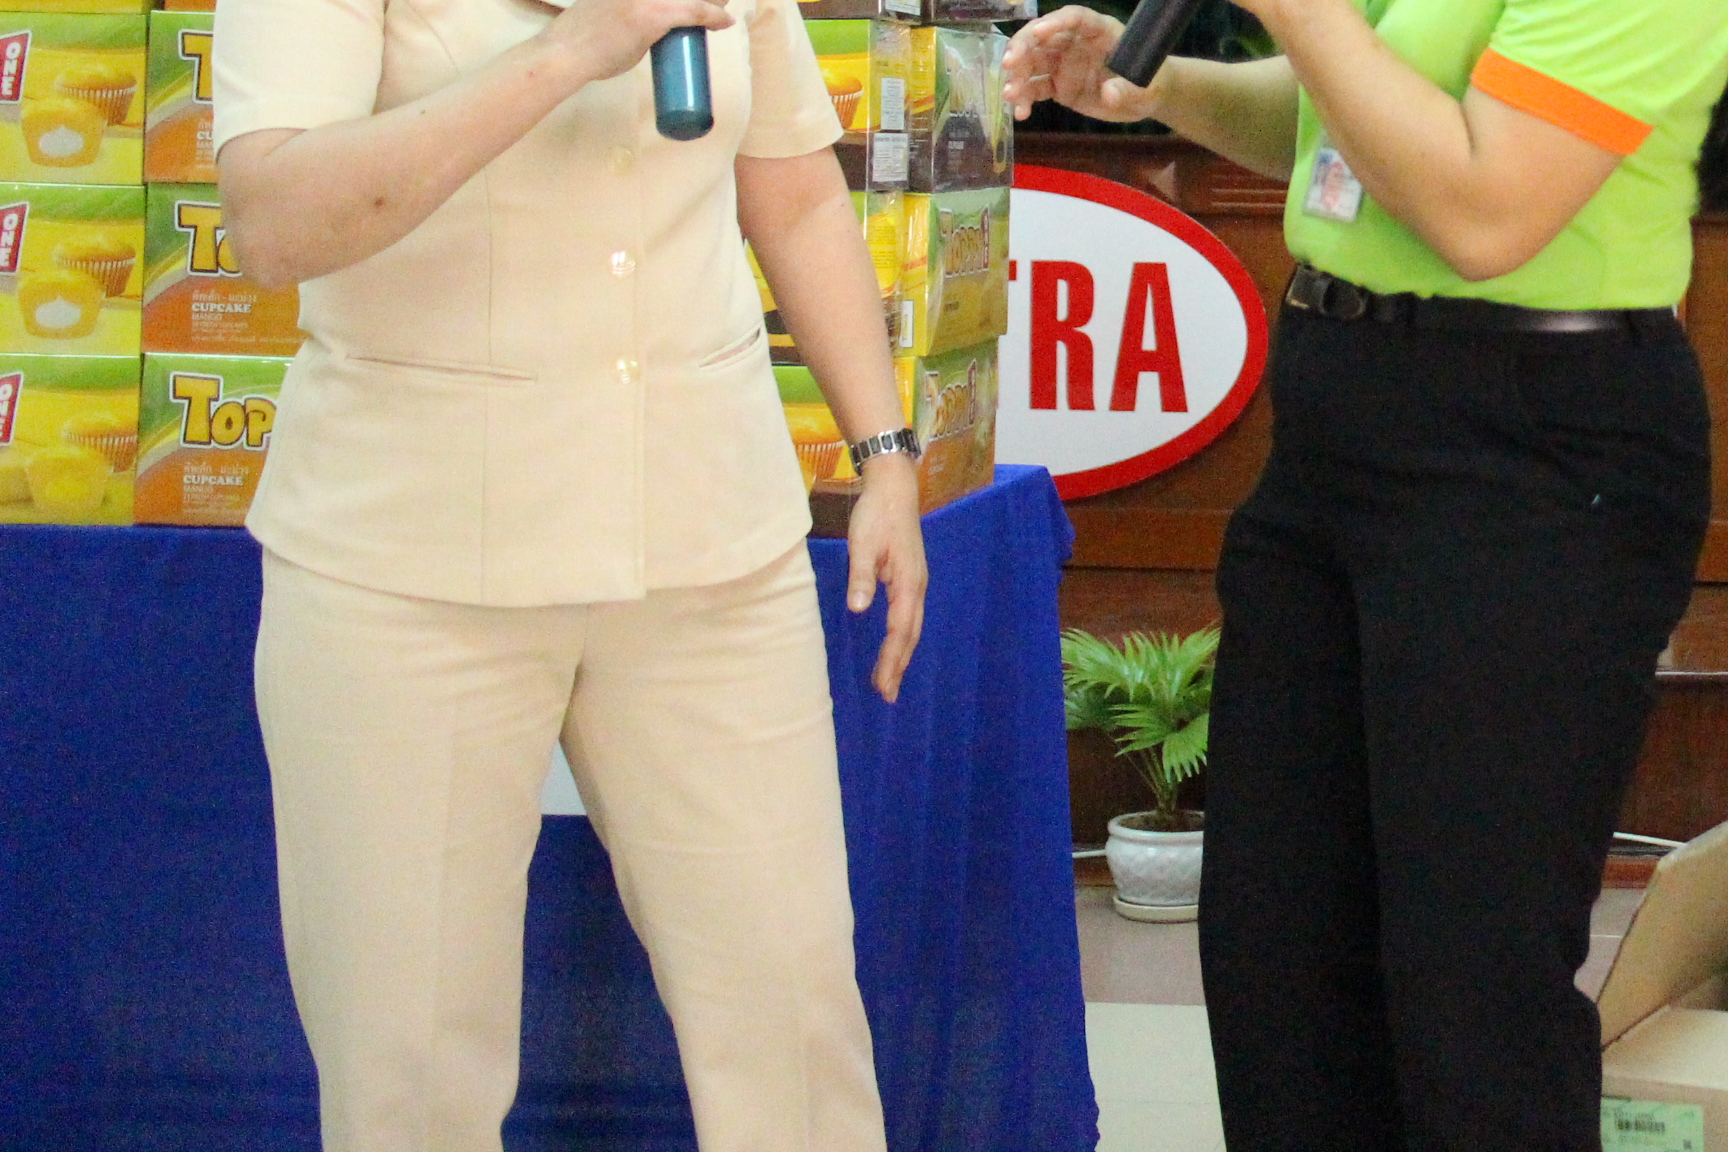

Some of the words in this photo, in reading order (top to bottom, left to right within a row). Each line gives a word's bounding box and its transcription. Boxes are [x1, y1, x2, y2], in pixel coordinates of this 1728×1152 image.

[1, 41, 22, 96] ONE
[0, 213, 19, 268] ONE
[192, 303, 252, 313] CUPCAKE
[1008, 260, 1189, 413] RA
[183, 475, 244, 486] CUPCAKE
